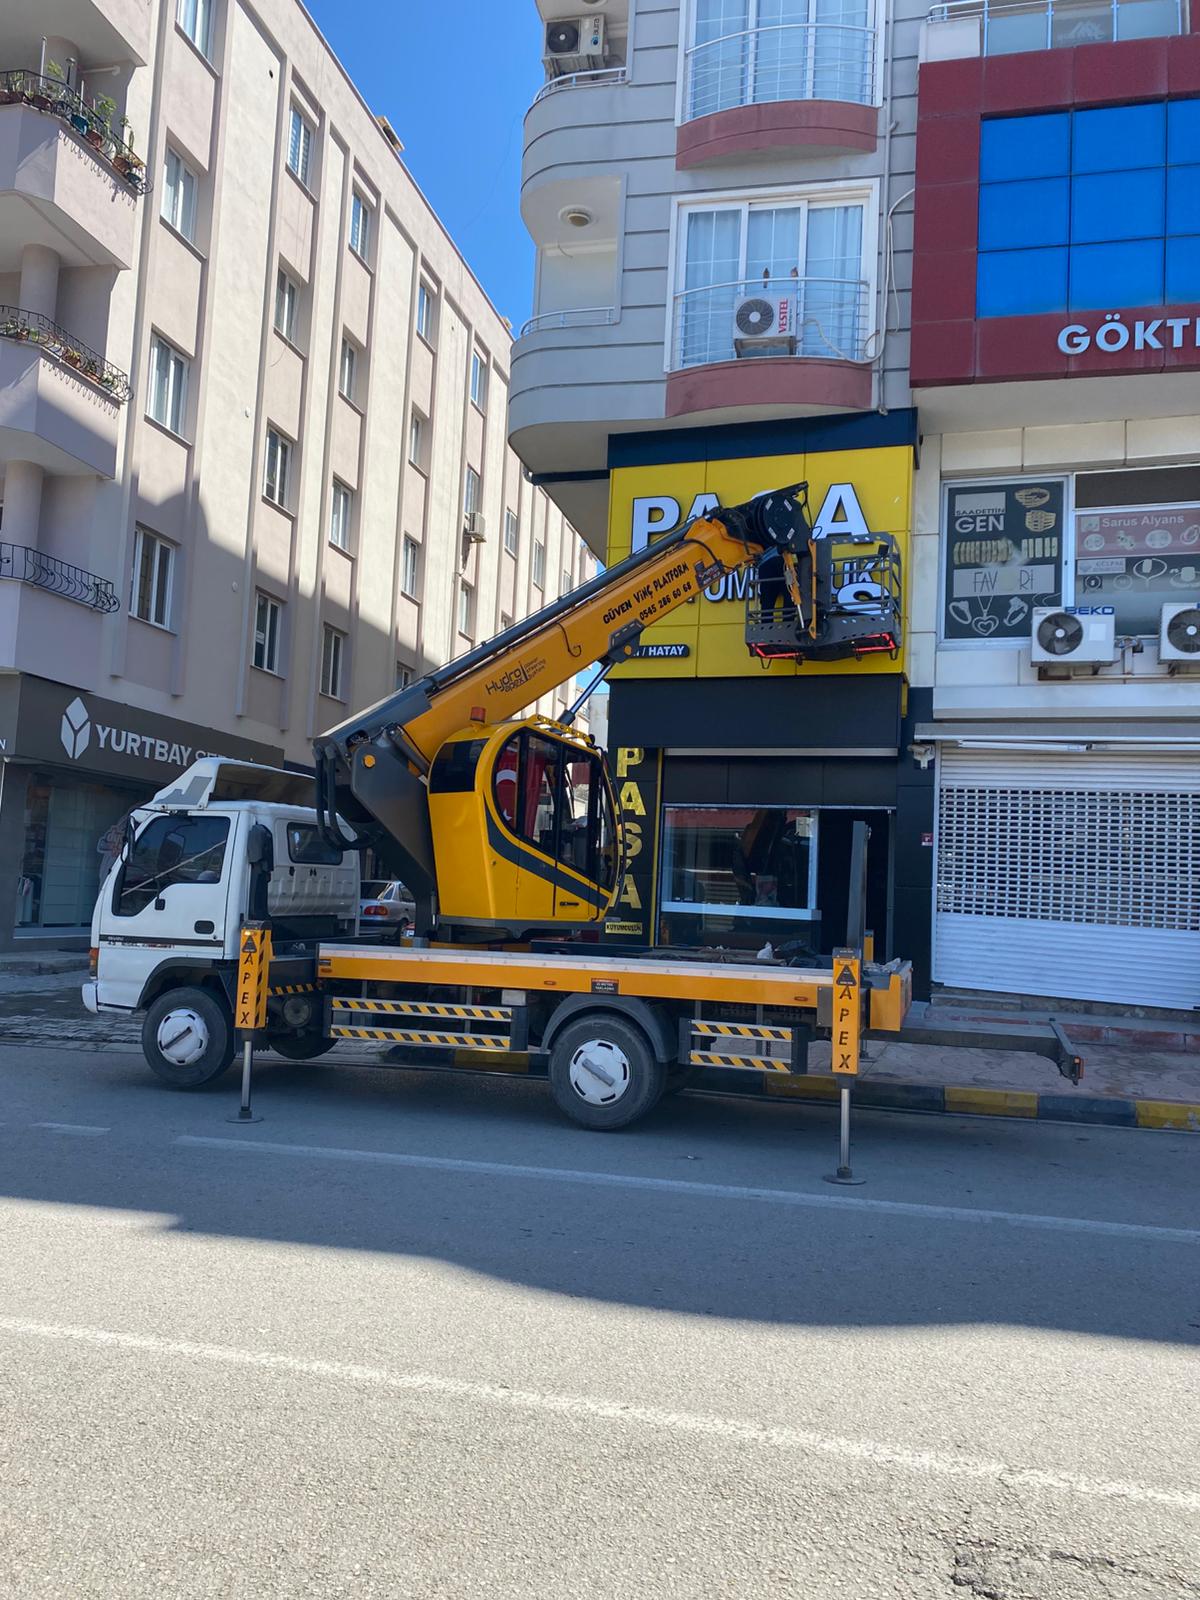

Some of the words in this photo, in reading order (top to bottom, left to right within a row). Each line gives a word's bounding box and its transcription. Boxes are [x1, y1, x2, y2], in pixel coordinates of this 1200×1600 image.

[631, 482, 870, 555] PAA
[955, 514, 1004, 533] GEN
[1102, 517, 1138, 528] Sarus
[1141, 515, 1185, 527] Alyans
[602, 598, 632, 624] GÜVEN
[653, 560, 689, 591] PLATFORM
[639, 603, 657, 621] 0545
[1064, 606, 1115, 615] BEKO
[648, 646, 685, 657] HATAY
[485, 667, 522, 695] Hydro
[95, 723, 192, 767] YURTBAY
[240, 953, 254, 1025] APEX
[839, 985, 852, 1069] APEX
